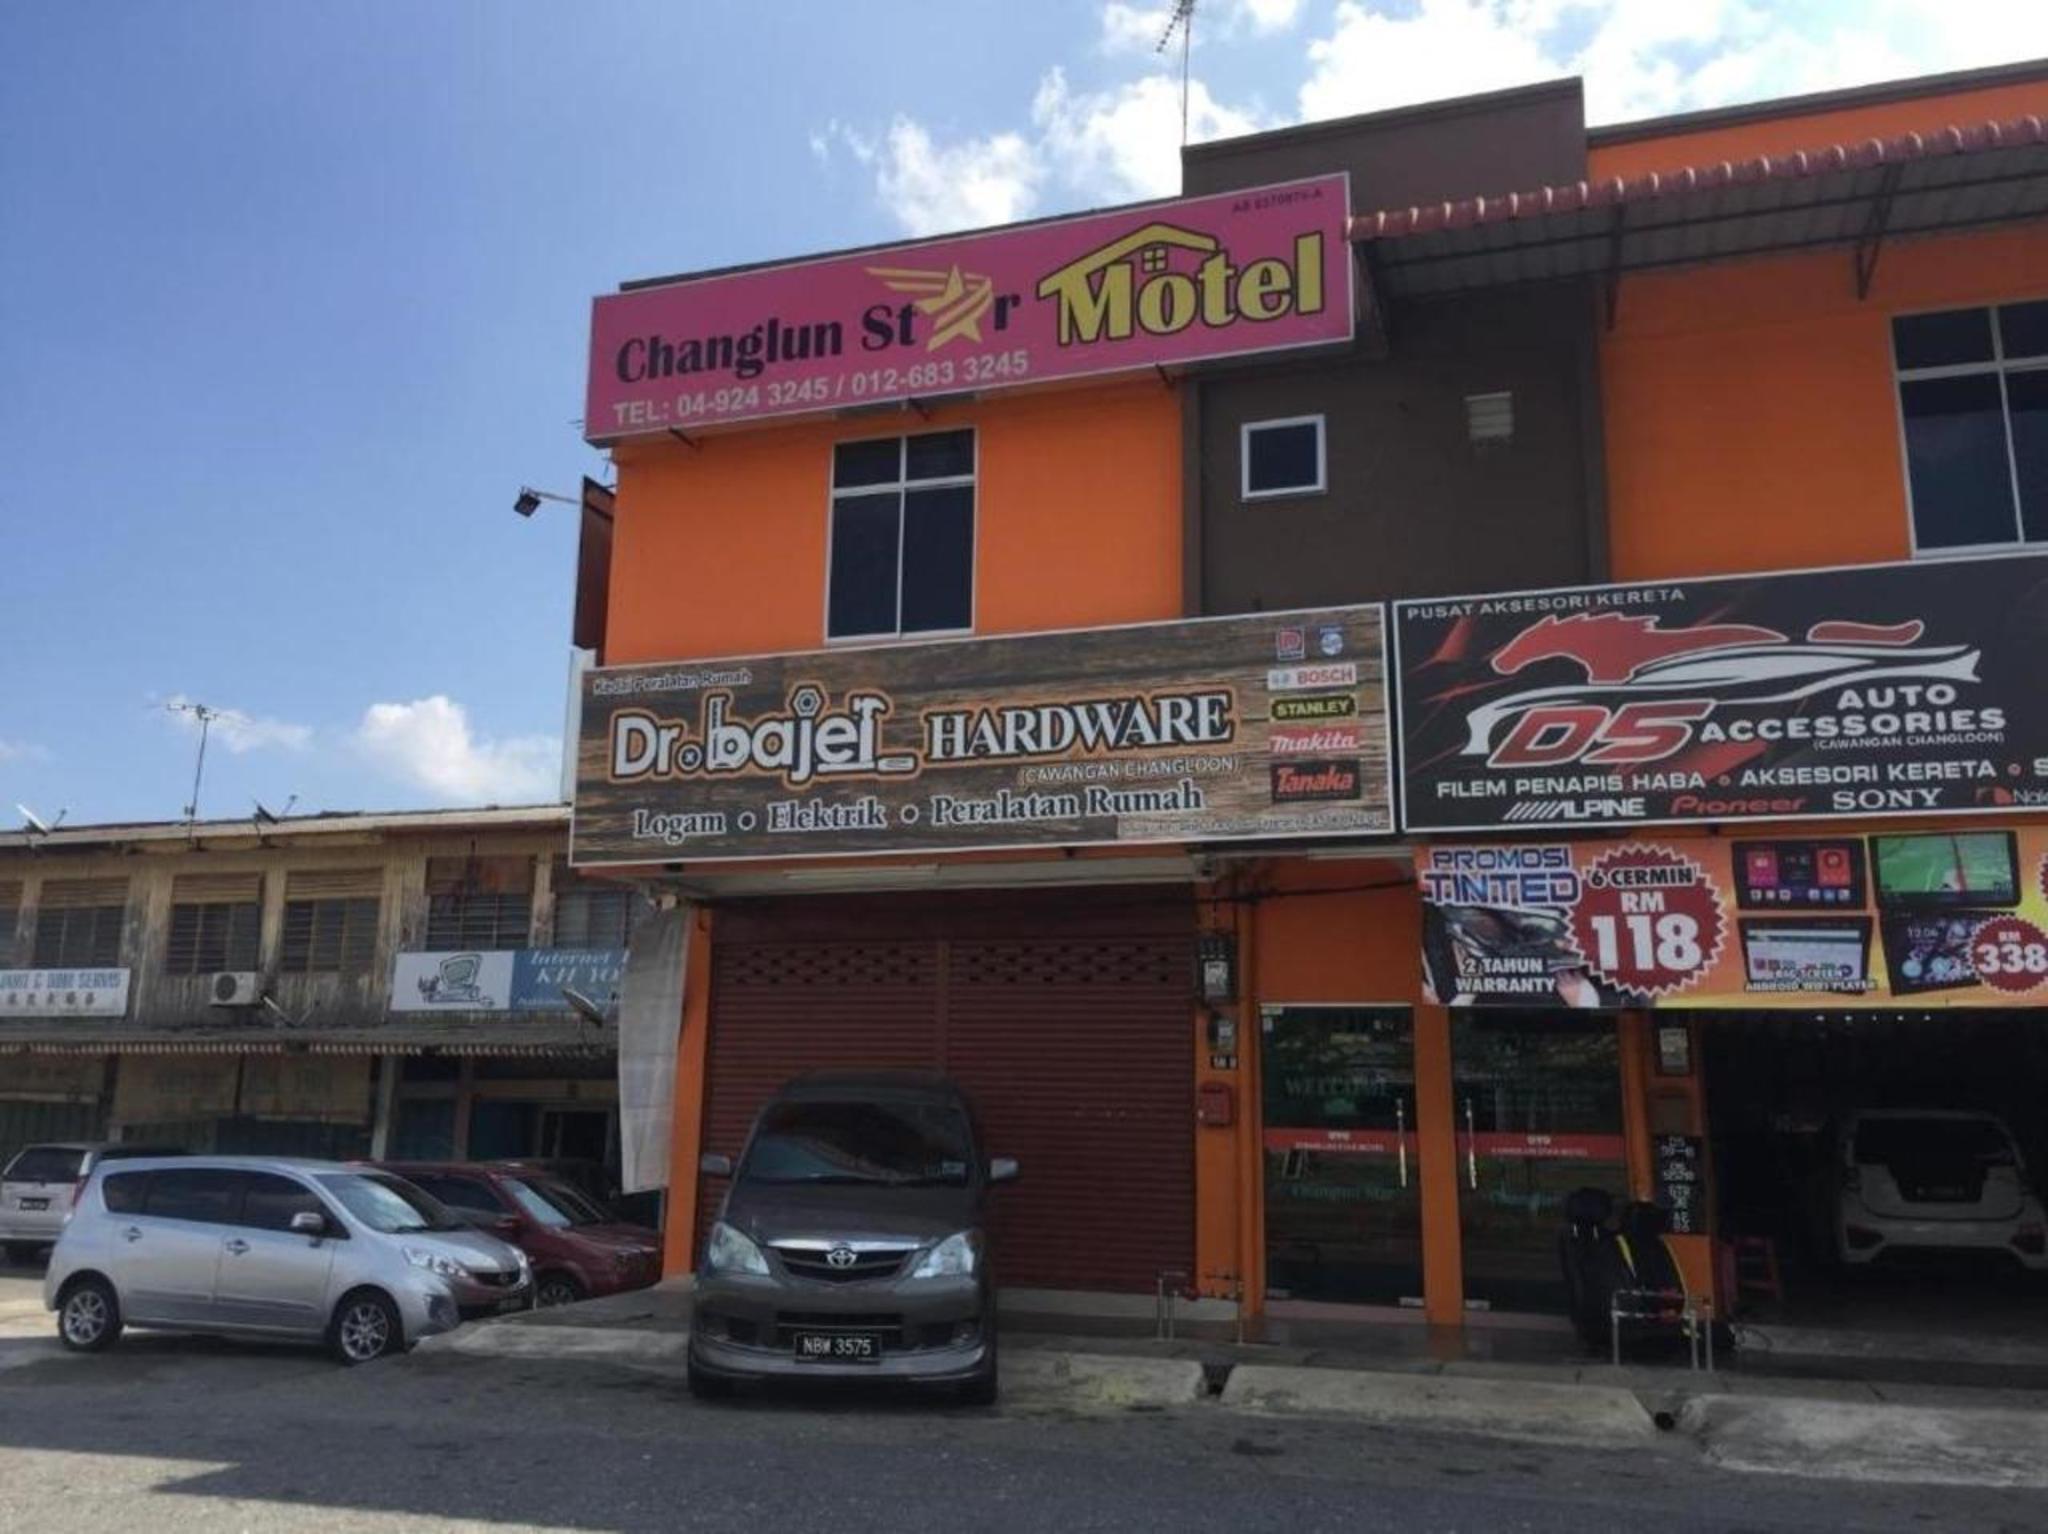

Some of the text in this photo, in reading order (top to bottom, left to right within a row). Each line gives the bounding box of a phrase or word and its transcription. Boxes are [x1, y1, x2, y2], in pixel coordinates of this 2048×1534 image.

[616, 316, 843, 387] Changlun
[1038, 223, 1327, 348] Motel
[612, 399, 670, 428] TEL:
[677, 386, 760, 419] 04-924
[766, 376, 830, 410] 3245
[851, 361, 956, 396] 012-683
[962, 349, 1031, 385] 3245
[1407, 588, 1686, 620] PUSAT AKSESORI KERETA
[700, 667, 752, 687] Rumah
[1297, 669, 1354, 686] BOSCH
[1275, 699, 1350, 717] STANLEY
[1836, 684, 1957, 710] AUTO
[928, 694, 1232, 760] HARDWARE
[1486, 699, 1717, 768] D5
[1700, 707, 2007, 743] ACCESSORIES
[1271, 730, 1359, 752] makita
[1276, 768, 1354, 794] Tanaka
[1437, 779, 1507, 798] FILEM
[1515, 776, 1624, 796] PENAPIS
[1631, 773, 1706, 791] HABA
[1740, 765, 1879, 788] AKSESORI
[1887, 759, 1998, 782] KERETA
[634, 811, 726, 844] Logam
[768, 799, 886, 832] Elektrik
[932, 789, 1085, 827] Peralatan
[1088, 778, 1203, 815] Rumah
[1670, 794, 1806, 815] Pioneer
[1832, 787, 1944, 811] SONY
[1432, 847, 1570, 870] PROMOSI
[1423, 872, 1580, 905] TINTED
[1610, 867, 1693, 886] CERMIN
[1621, 892, 1665, 914] RM
[1591, 913, 1701, 970] 118
[1463, 957, 1543, 973] 2 TAHUN
[1977, 943, 2048, 974] 338
[1455, 977, 1556, 993] WARRANTY
[834, 1338, 872, 1355] 3575
